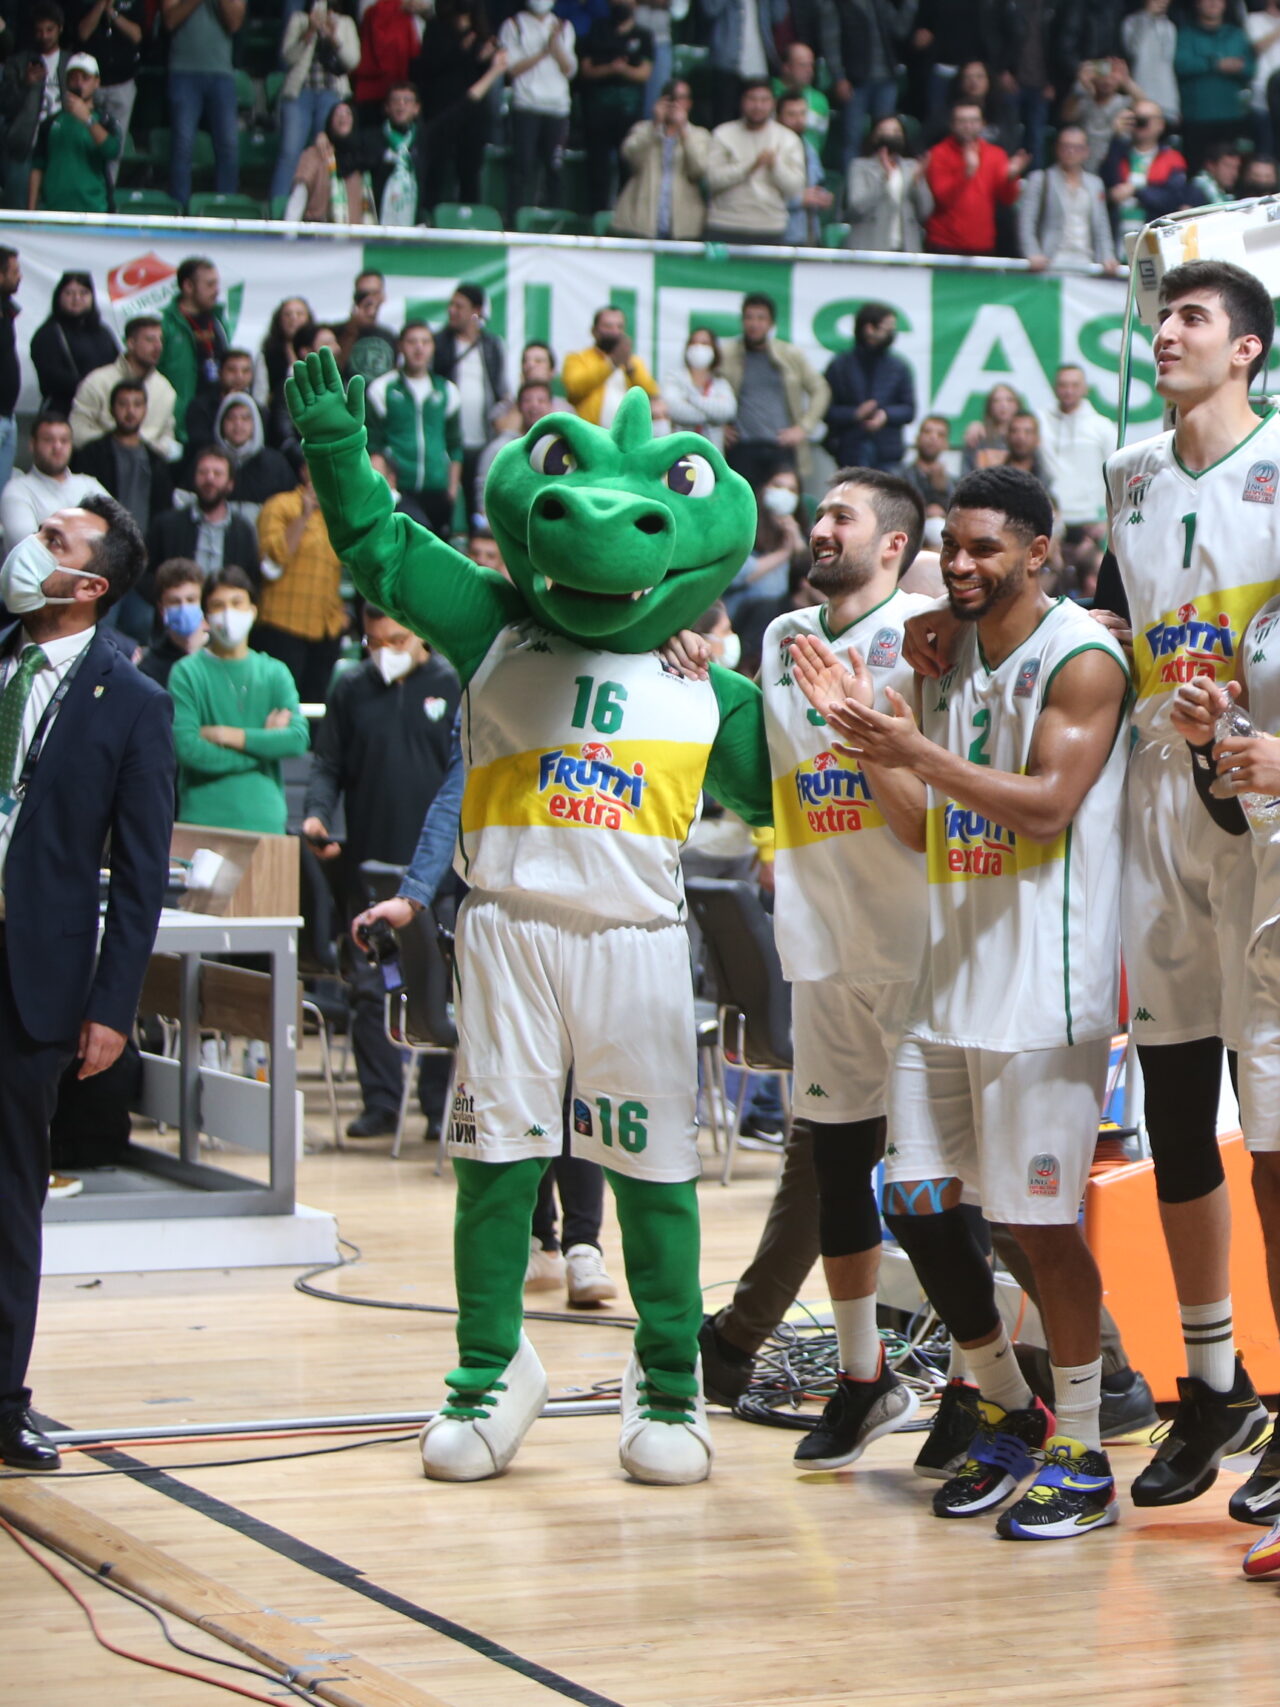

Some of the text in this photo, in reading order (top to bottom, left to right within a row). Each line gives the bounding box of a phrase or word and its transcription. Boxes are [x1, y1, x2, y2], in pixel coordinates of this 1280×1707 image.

[1181, 511, 1198, 569] 1
[1160, 655, 1216, 683] xtra
[570, 675, 629, 735] 16
[967, 707, 992, 765] 2
[548, 793, 622, 831] extra
[807, 804, 862, 833] extra
[947, 846, 1003, 877] extra
[453, 1094, 475, 1113] ent
[596, 1096, 649, 1153] 16
